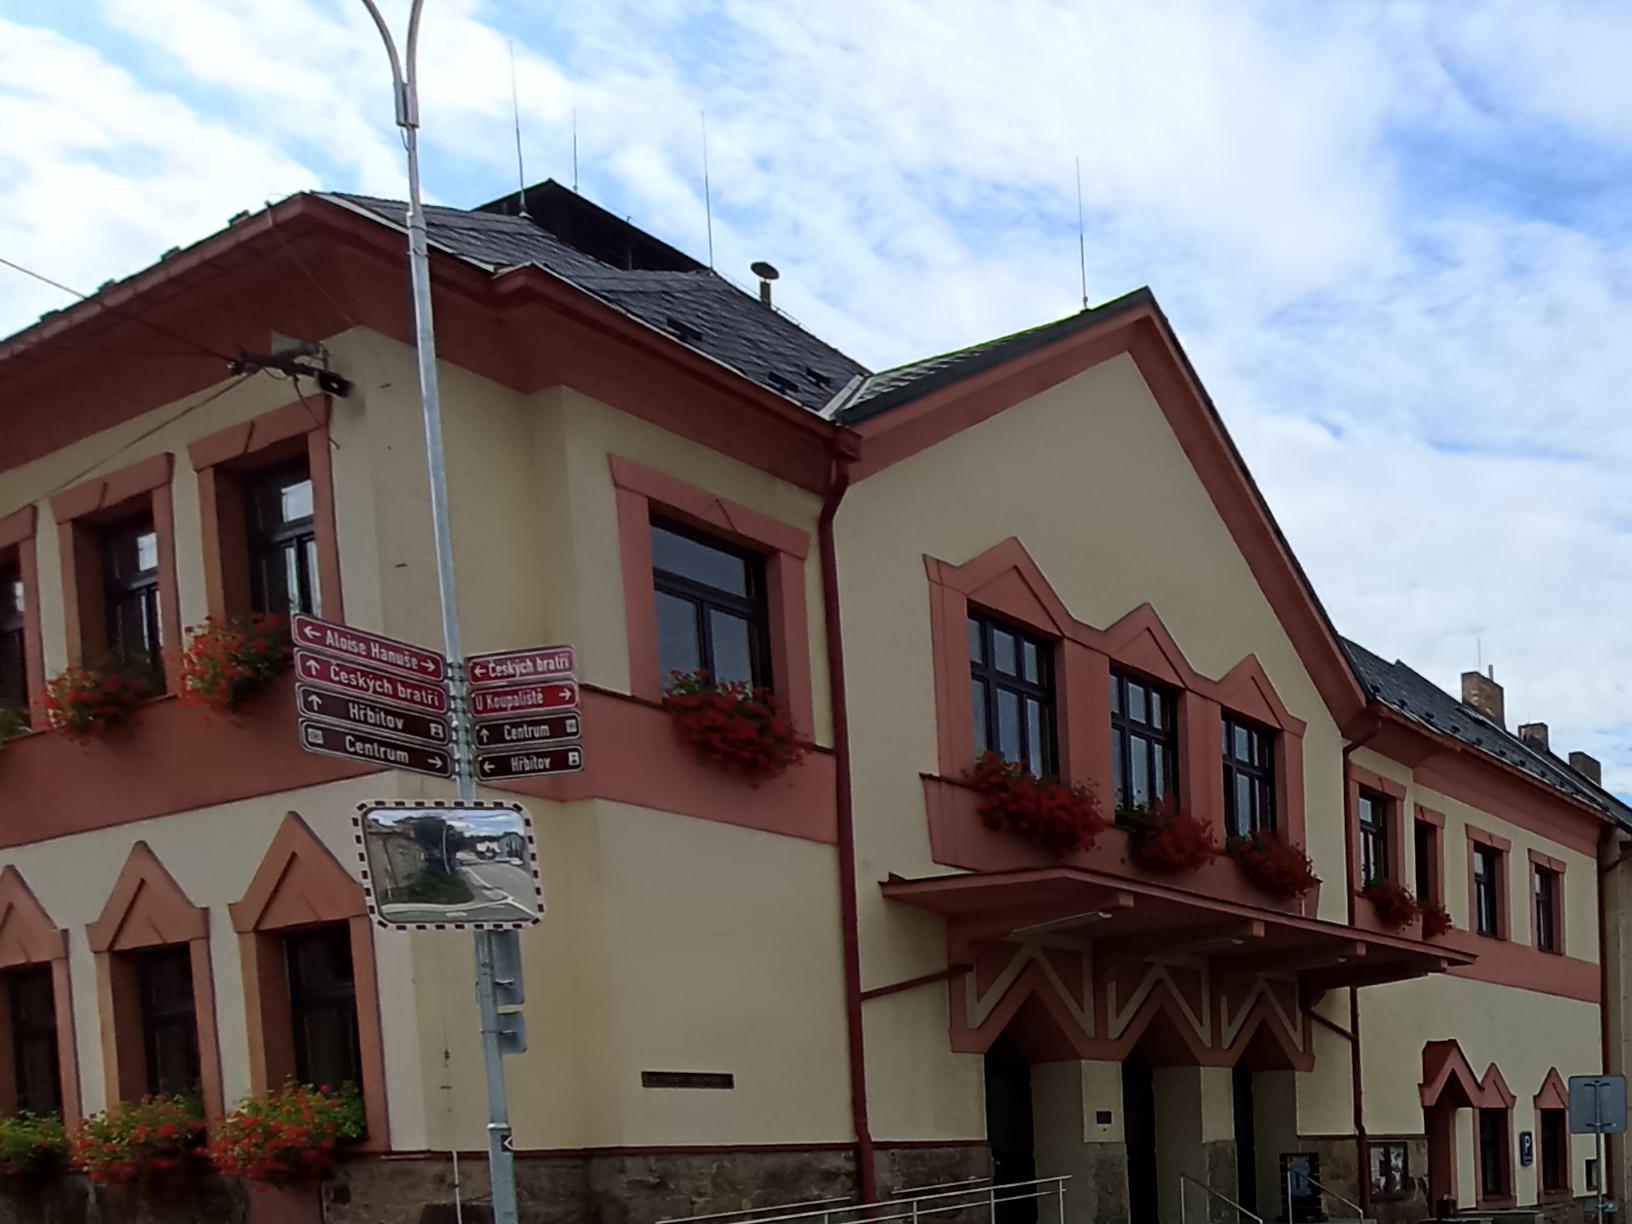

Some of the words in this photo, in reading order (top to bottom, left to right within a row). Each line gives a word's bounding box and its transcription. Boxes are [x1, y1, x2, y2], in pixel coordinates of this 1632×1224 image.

[325, 630, 367, 655] Aloise
[371, 642, 418, 669] Hanuše
[489, 659, 534, 678] Českých
[536, 653, 570, 672] bratří
[330, 660, 393, 694] Českých
[397, 683, 439, 706] bratří
[476, 694, 483, 710] U
[486, 688, 544, 711] Koupaliště
[348, 702, 404, 730] Hřbitov
[504, 724, 550, 740] Centrum
[344, 735, 409, 763] Centrum
[511, 756, 551, 772] Hřbitov
